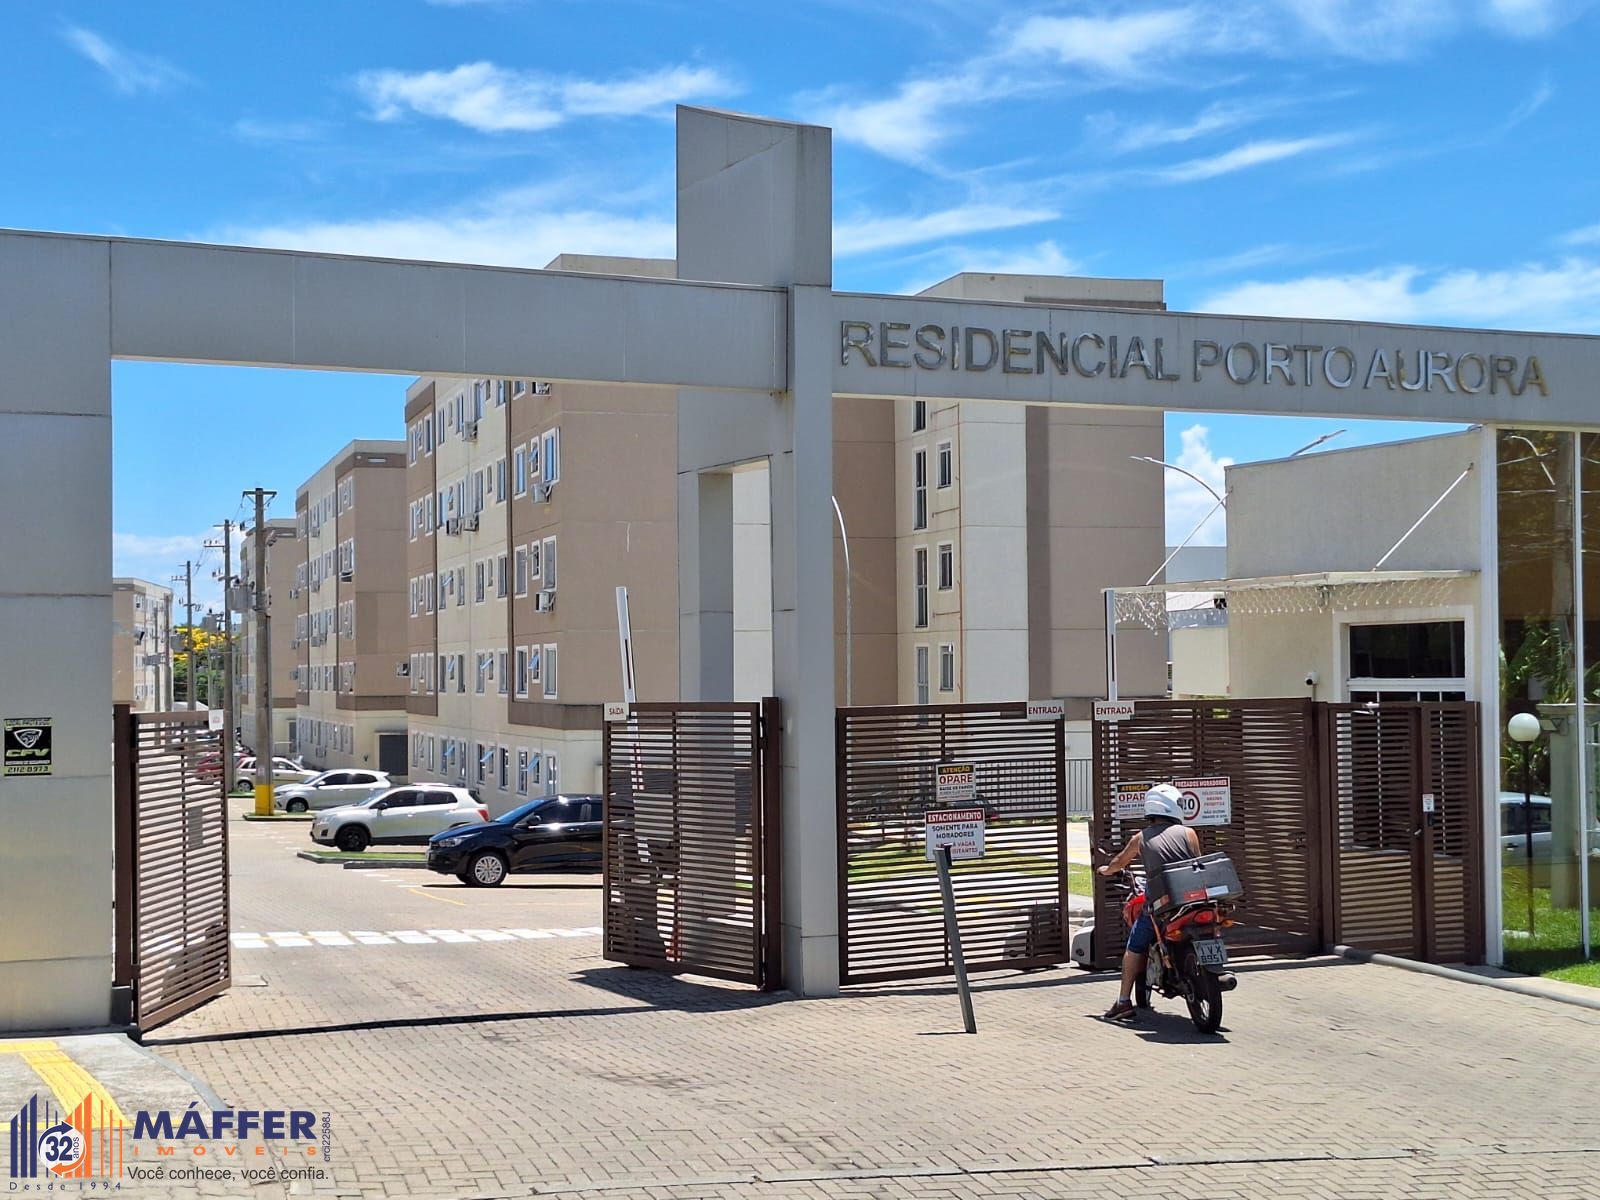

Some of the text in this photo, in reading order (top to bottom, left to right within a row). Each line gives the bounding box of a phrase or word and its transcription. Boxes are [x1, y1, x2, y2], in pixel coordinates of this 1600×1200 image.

[841, 320, 1548, 396] RESIDENCIAL PORTO AURORA
[1028, 706, 1063, 715] ENTRADA
[1096, 706, 1132, 715] ENTRADA
[943, 765, 970, 773] ATENÇÃO
[940, 774, 973, 784] OPARE
[1119, 793, 1145, 802] OPAR
[928, 812, 981, 822] ESTACIONAMENTO
